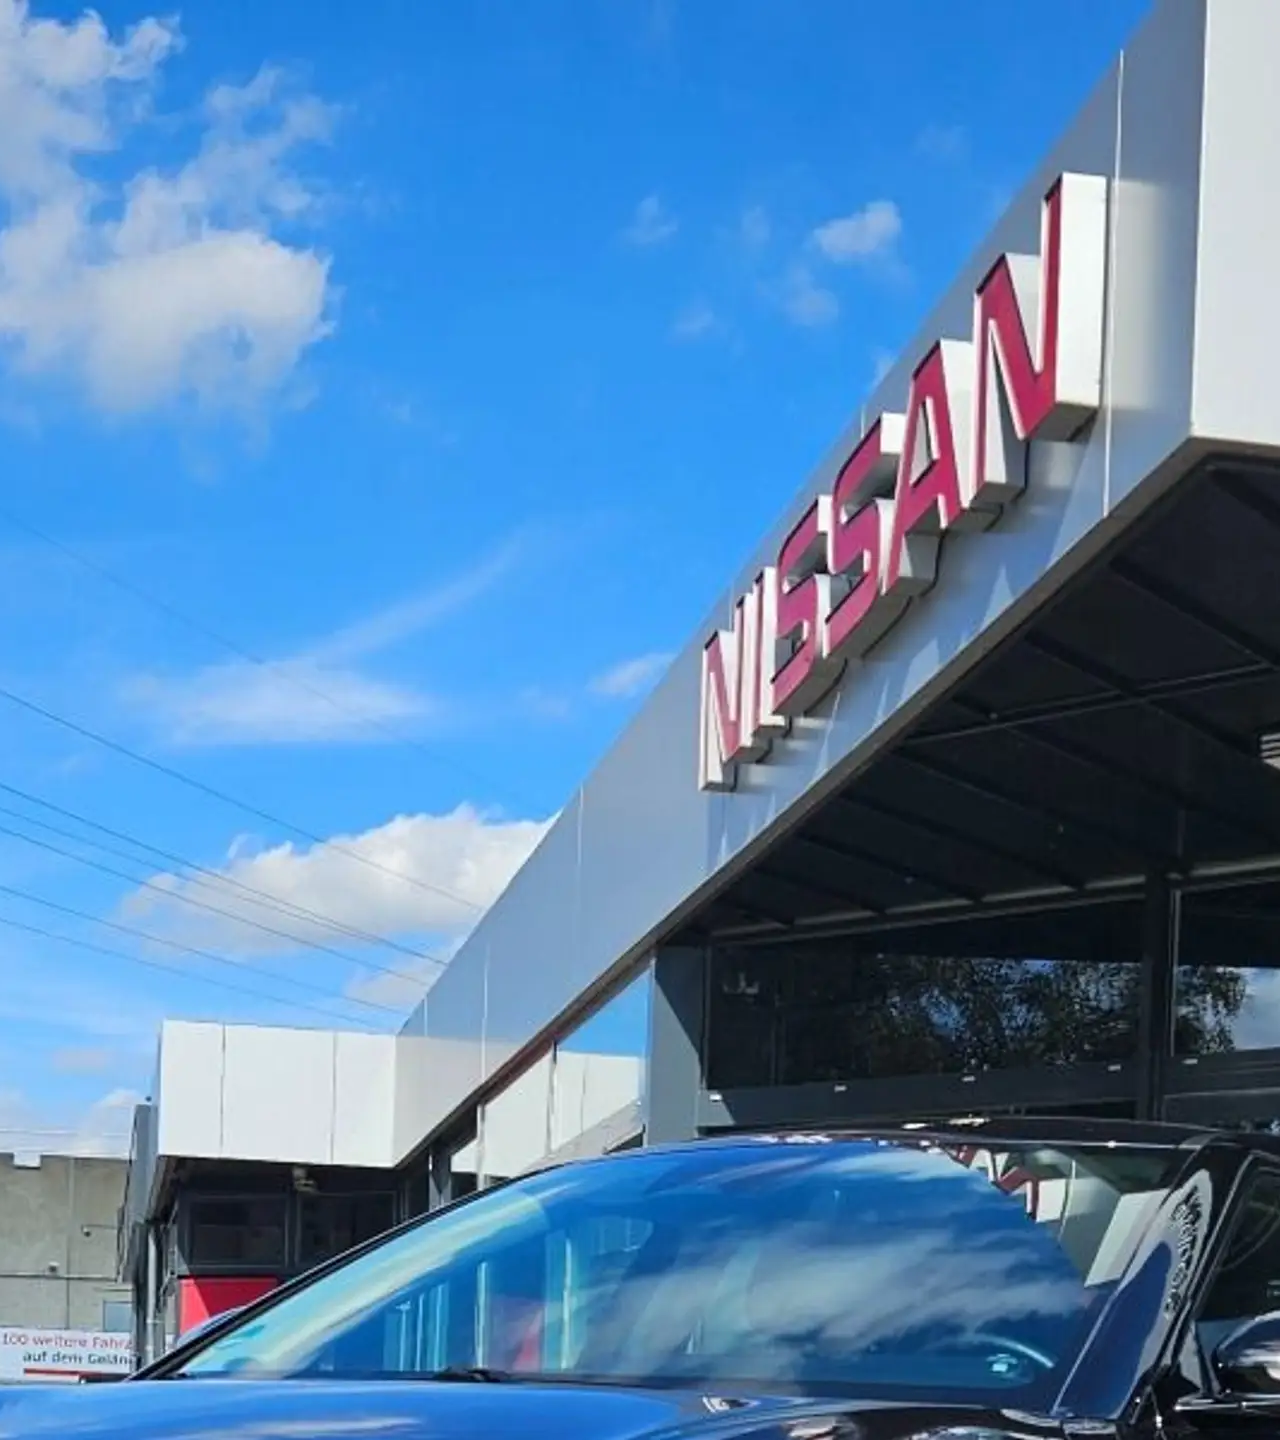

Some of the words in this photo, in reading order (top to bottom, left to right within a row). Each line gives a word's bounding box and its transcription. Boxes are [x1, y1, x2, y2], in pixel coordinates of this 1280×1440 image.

[698, 171, 1109, 792] NISSAN
[3, 1332, 29, 1346] 100
[31, 1334, 88, 1349] weitere
[93, 1337, 134, 1350] Fahrz
[22, 1350, 47, 1364] auf
[52, 1352, 82, 1365] dem
